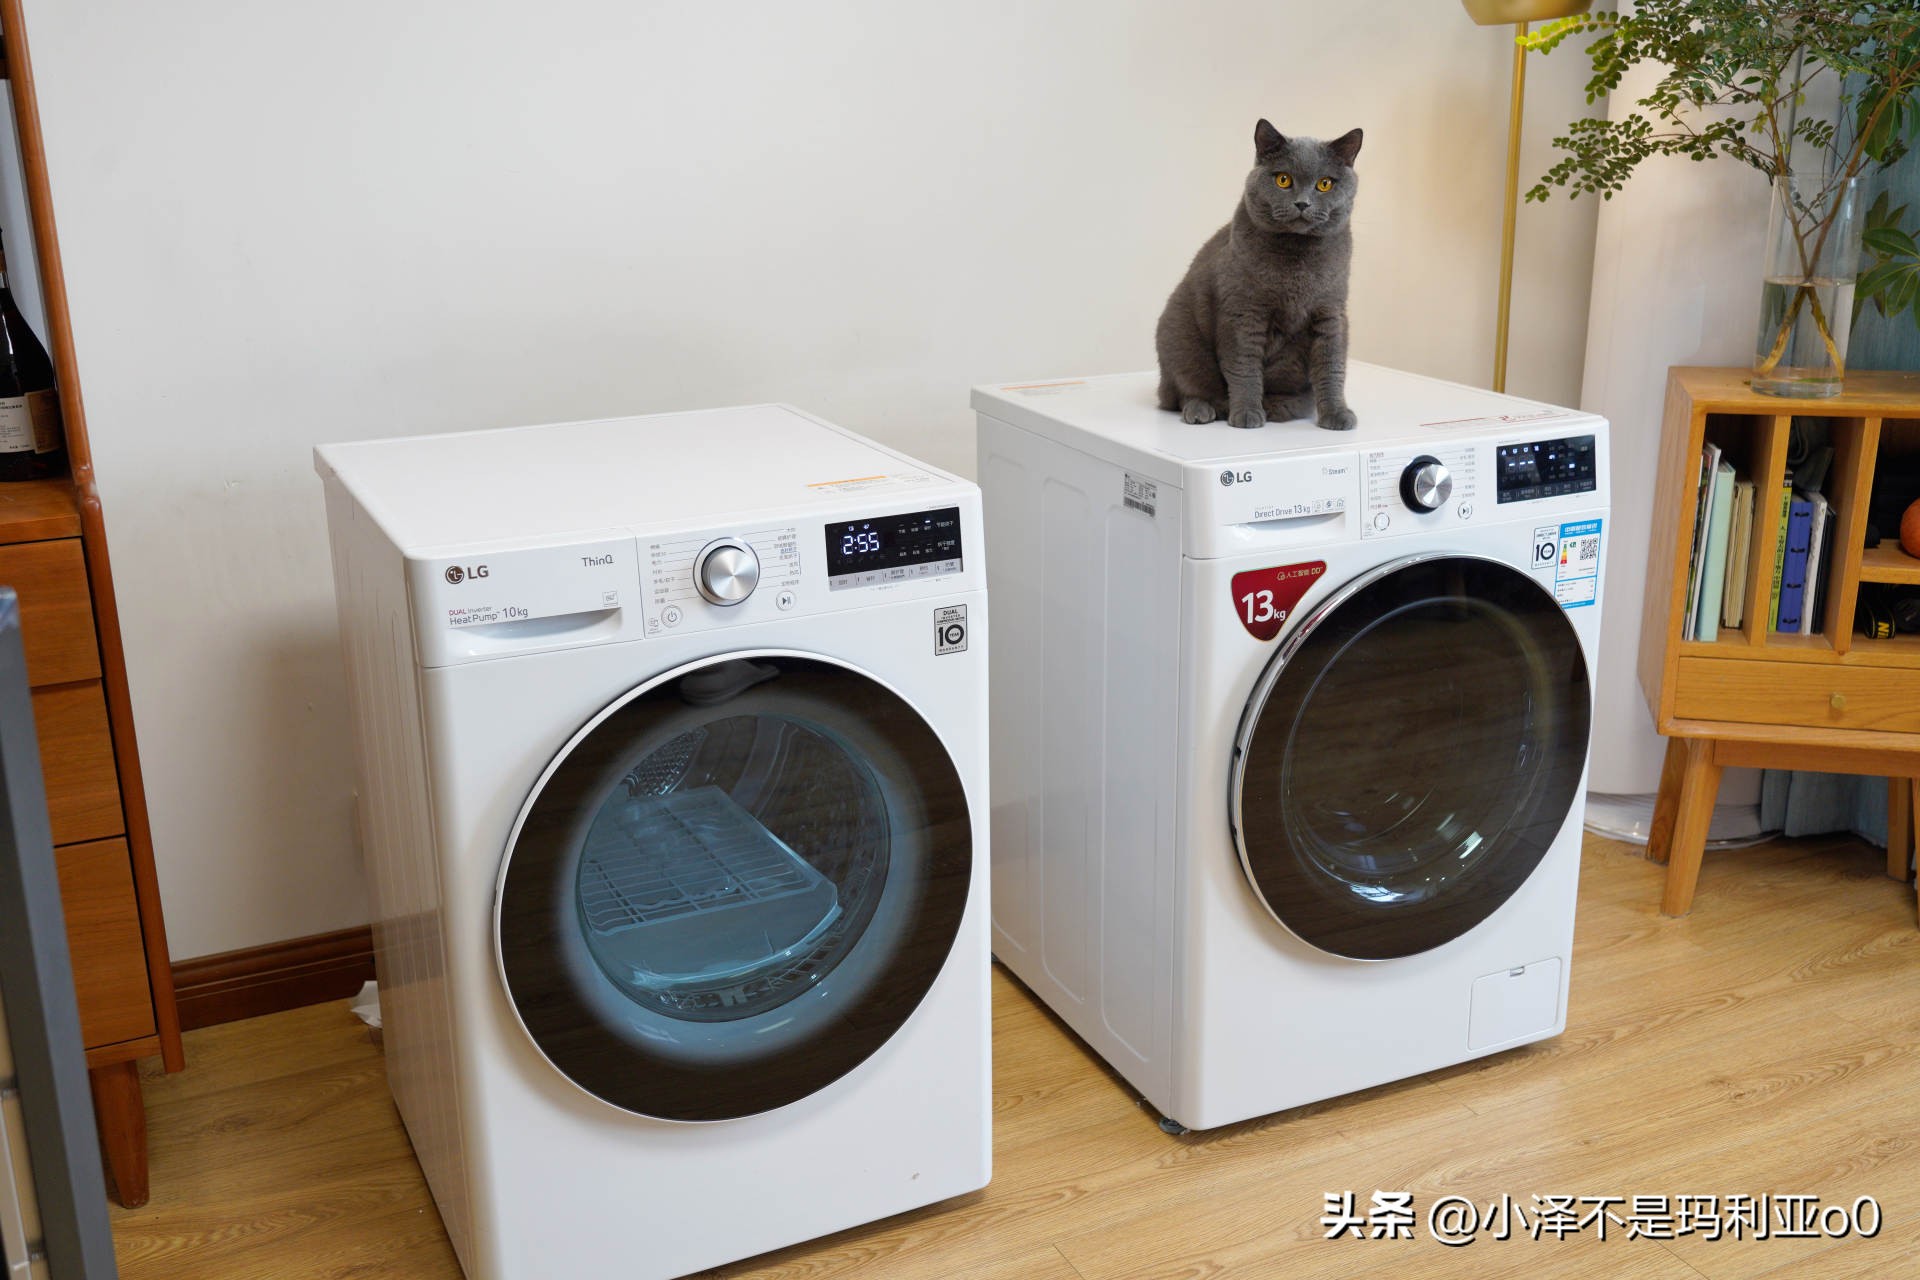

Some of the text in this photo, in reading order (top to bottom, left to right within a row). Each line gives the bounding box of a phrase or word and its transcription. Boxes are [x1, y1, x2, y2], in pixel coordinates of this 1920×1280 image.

[1237, 472, 1252, 483] LG
[1254, 510, 1274, 519] Direct
[1275, 508, 1293, 516] Drive
[842, 532, 880, 555] 2:55
[1536, 542, 1556, 561] 10
[581, 554, 614, 568] ThinQ
[467, 565, 489, 580] LG
[468, 606, 492, 614] Inverter
[938, 624, 965, 647] 10
